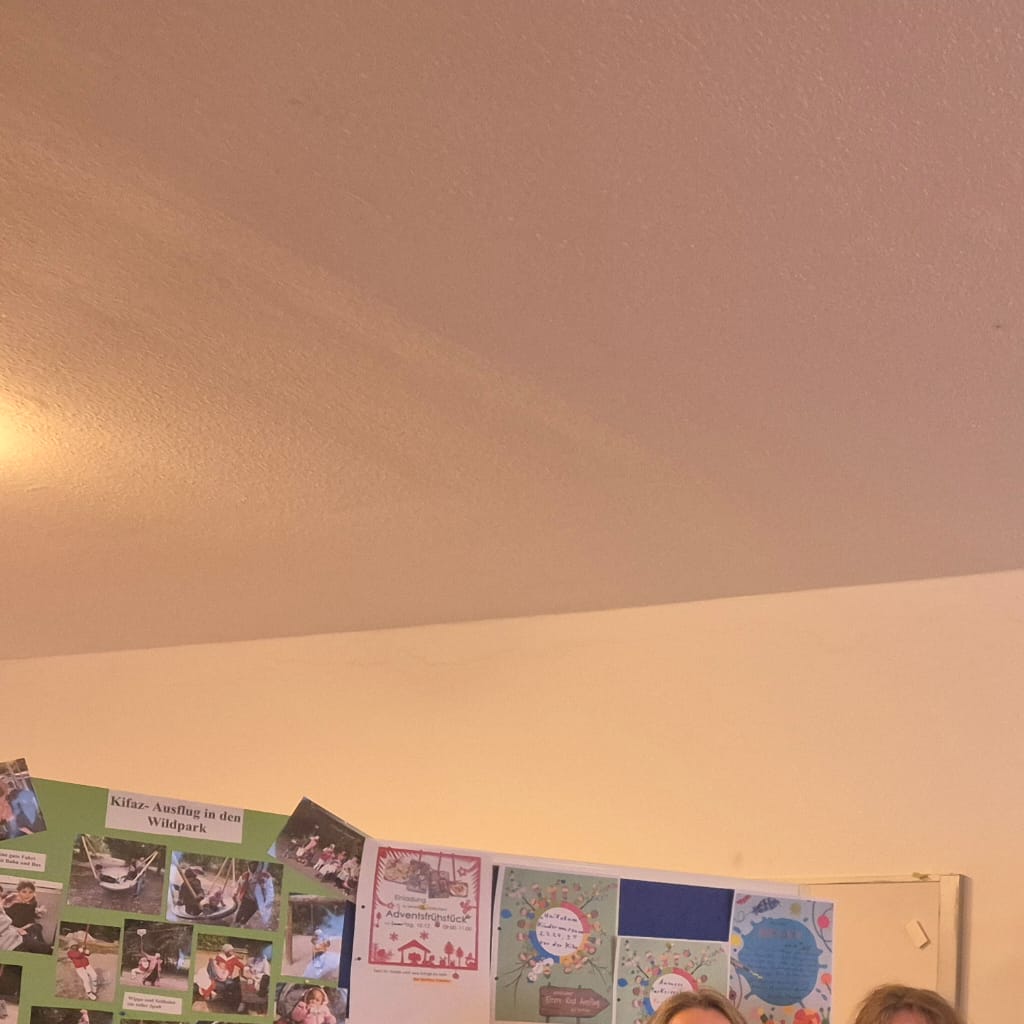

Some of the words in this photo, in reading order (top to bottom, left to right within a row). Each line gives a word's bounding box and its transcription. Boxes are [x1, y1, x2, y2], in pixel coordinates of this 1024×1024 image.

[111, 796, 149, 810] Kifaz-
[152, 802, 201, 819] Ausflug
[204, 809, 216, 819] in
[219, 811, 241, 823] den
[148, 816, 207, 833] Wildpark
[386, 910, 467, 924] Adventsfrühstück
